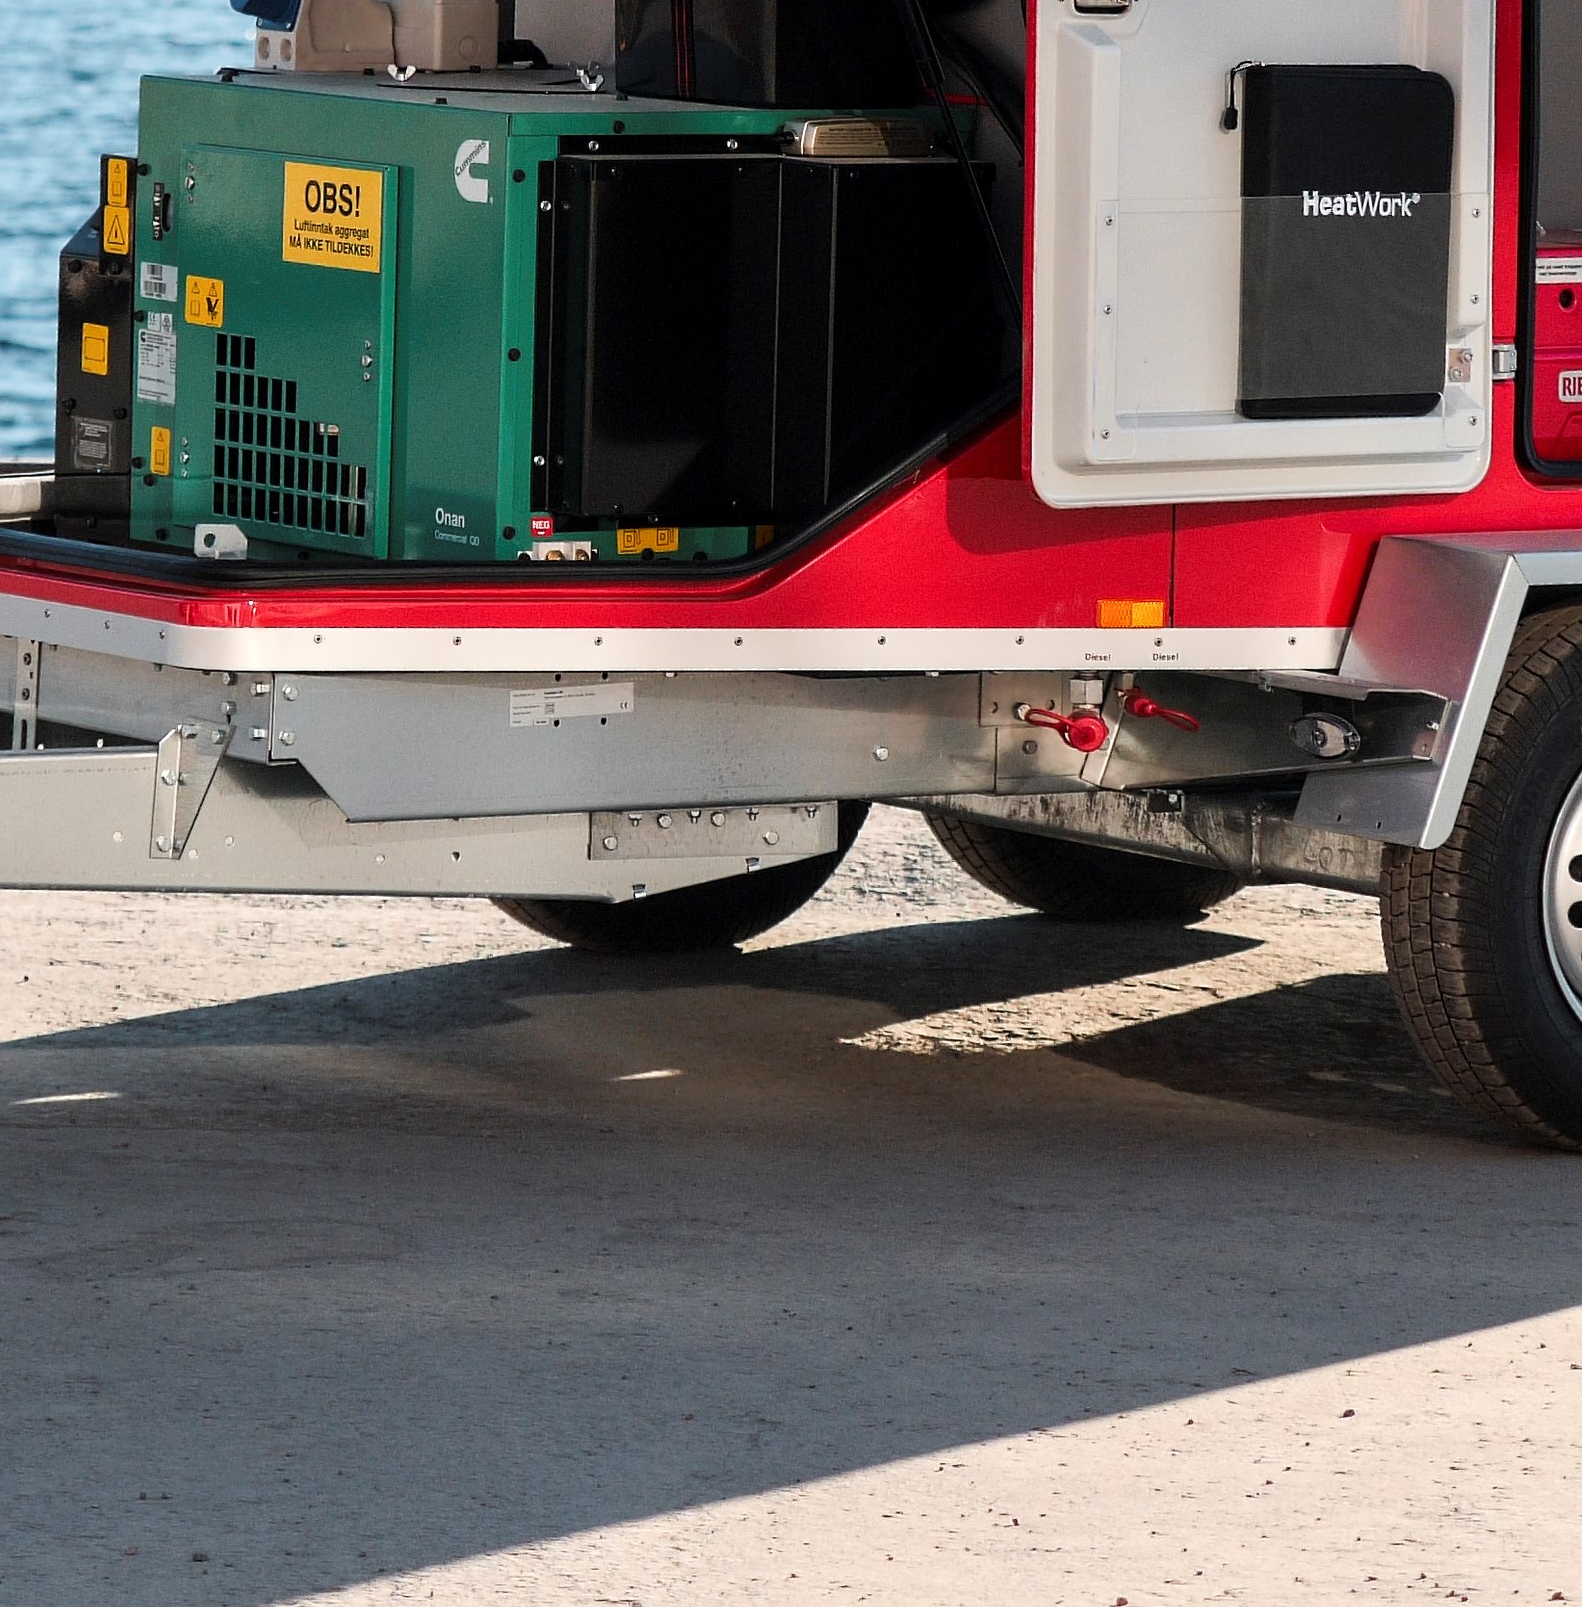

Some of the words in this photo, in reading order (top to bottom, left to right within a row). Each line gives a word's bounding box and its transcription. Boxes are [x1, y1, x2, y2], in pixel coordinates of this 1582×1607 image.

[304, 179, 361, 218] OBS!
[334, 225, 370, 241] aggregat
[289, 233, 302, 249] MÅ
[303, 237, 324, 252] IKKE
[325, 240, 374, 258] TILDEKKES!
[435, 507, 465, 528] Onan
[1084, 652, 1111, 661] Diesel
[1152, 652, 1179, 661] Diesel
